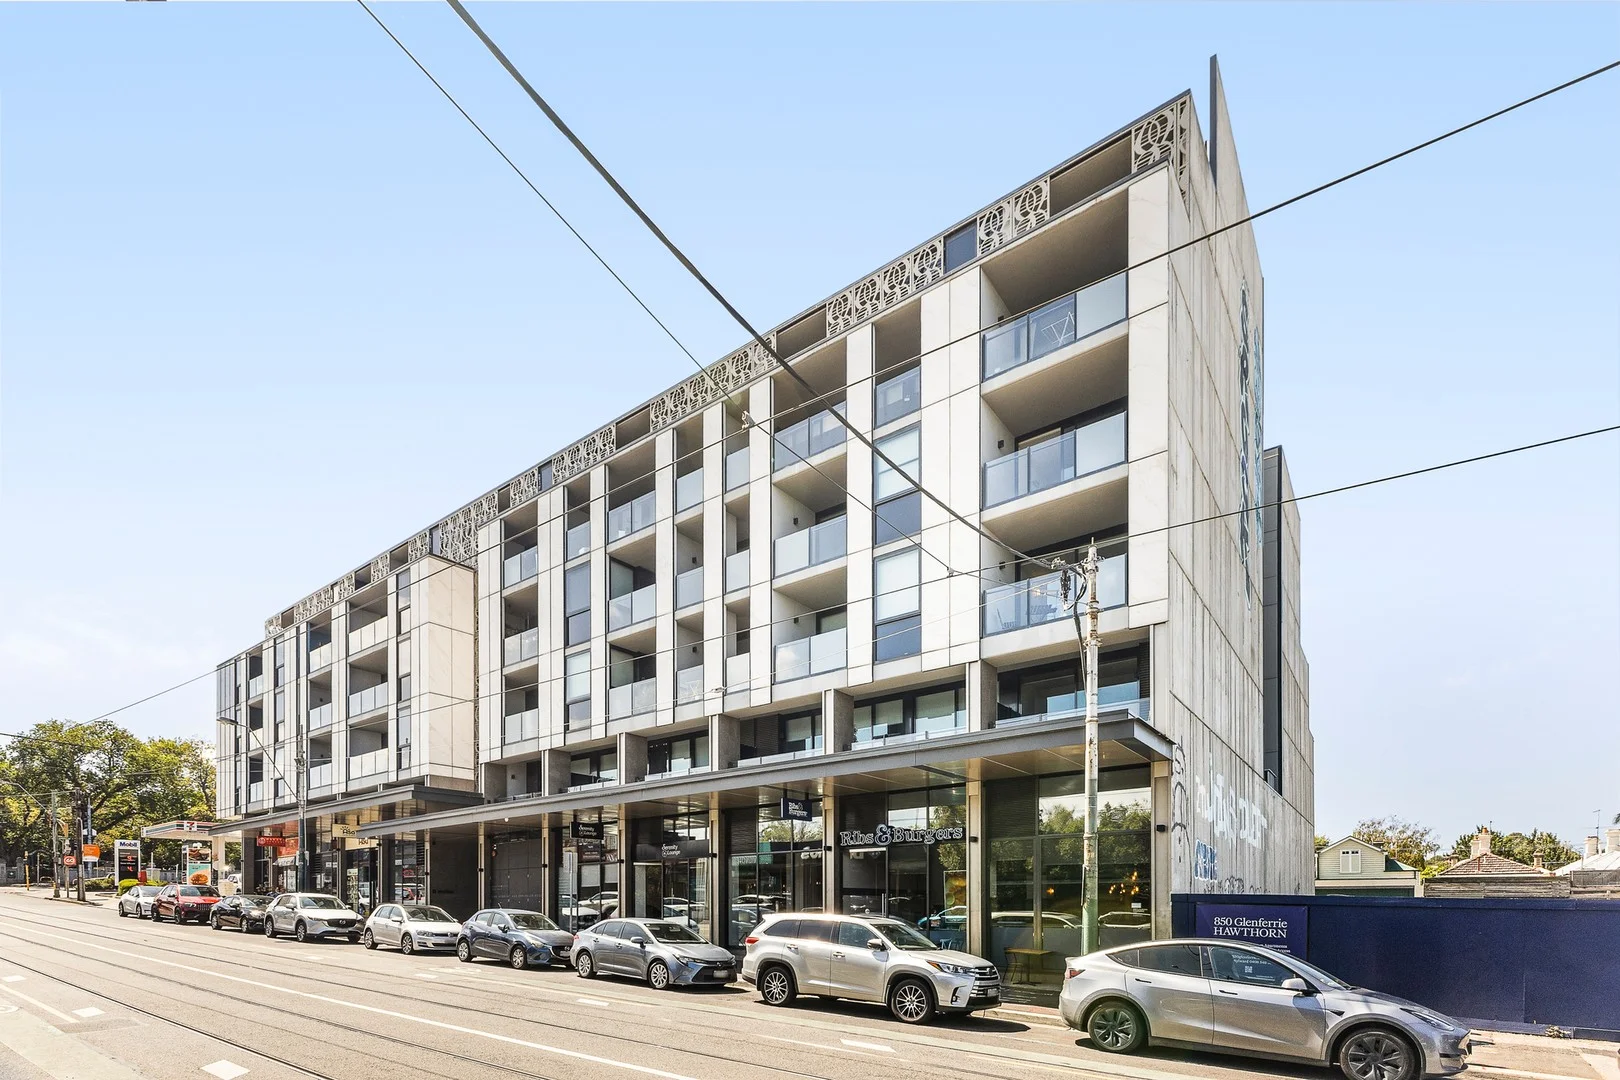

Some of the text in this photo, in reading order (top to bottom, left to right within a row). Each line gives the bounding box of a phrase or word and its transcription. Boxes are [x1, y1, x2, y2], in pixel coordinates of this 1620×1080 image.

[840, 823, 963, 846] Ribs & Burgers
[1213, 917, 1288, 928] 850 Glenferrie
[1213, 927, 1287, 938] HAWTHORN
